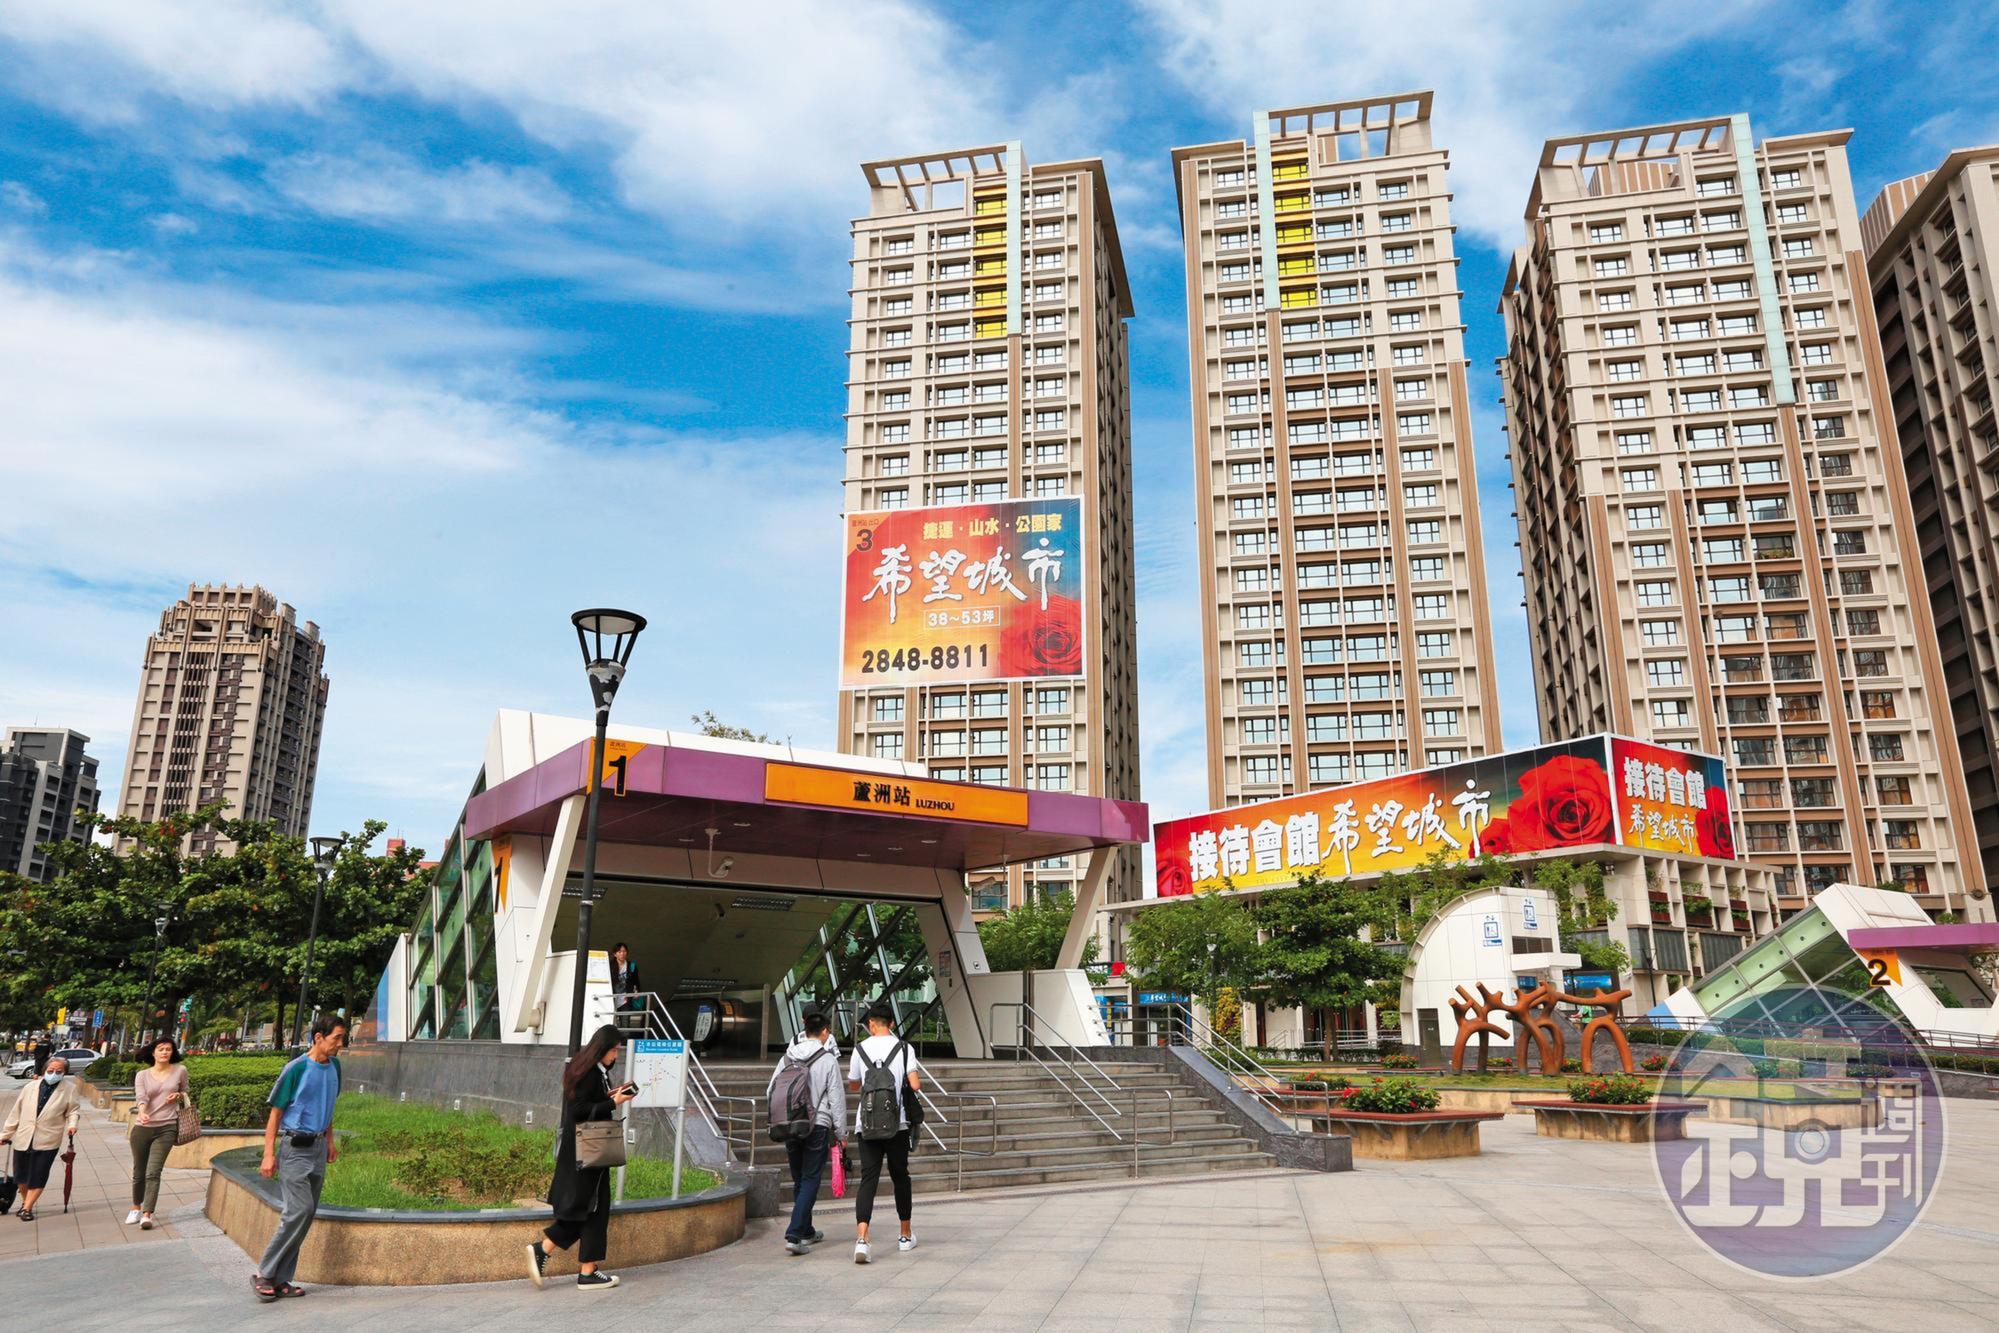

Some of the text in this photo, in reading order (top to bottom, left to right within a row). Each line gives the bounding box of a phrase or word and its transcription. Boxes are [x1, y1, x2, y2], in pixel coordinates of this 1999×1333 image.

[856, 529, 873, 551] 3
[862, 538, 1064, 624] 希望城市
[862, 644, 987, 673] 2848-8811
[609, 755, 627, 796] 1
[853, 781, 955, 811] 蘆洲站 LUZHOU
[1624, 757, 1707, 810] 接待會館
[1189, 779, 1491, 882] 接待會館 希望城市
[1628, 804, 1695, 853] 希望城市
[1868, 959, 1891, 987] 2
